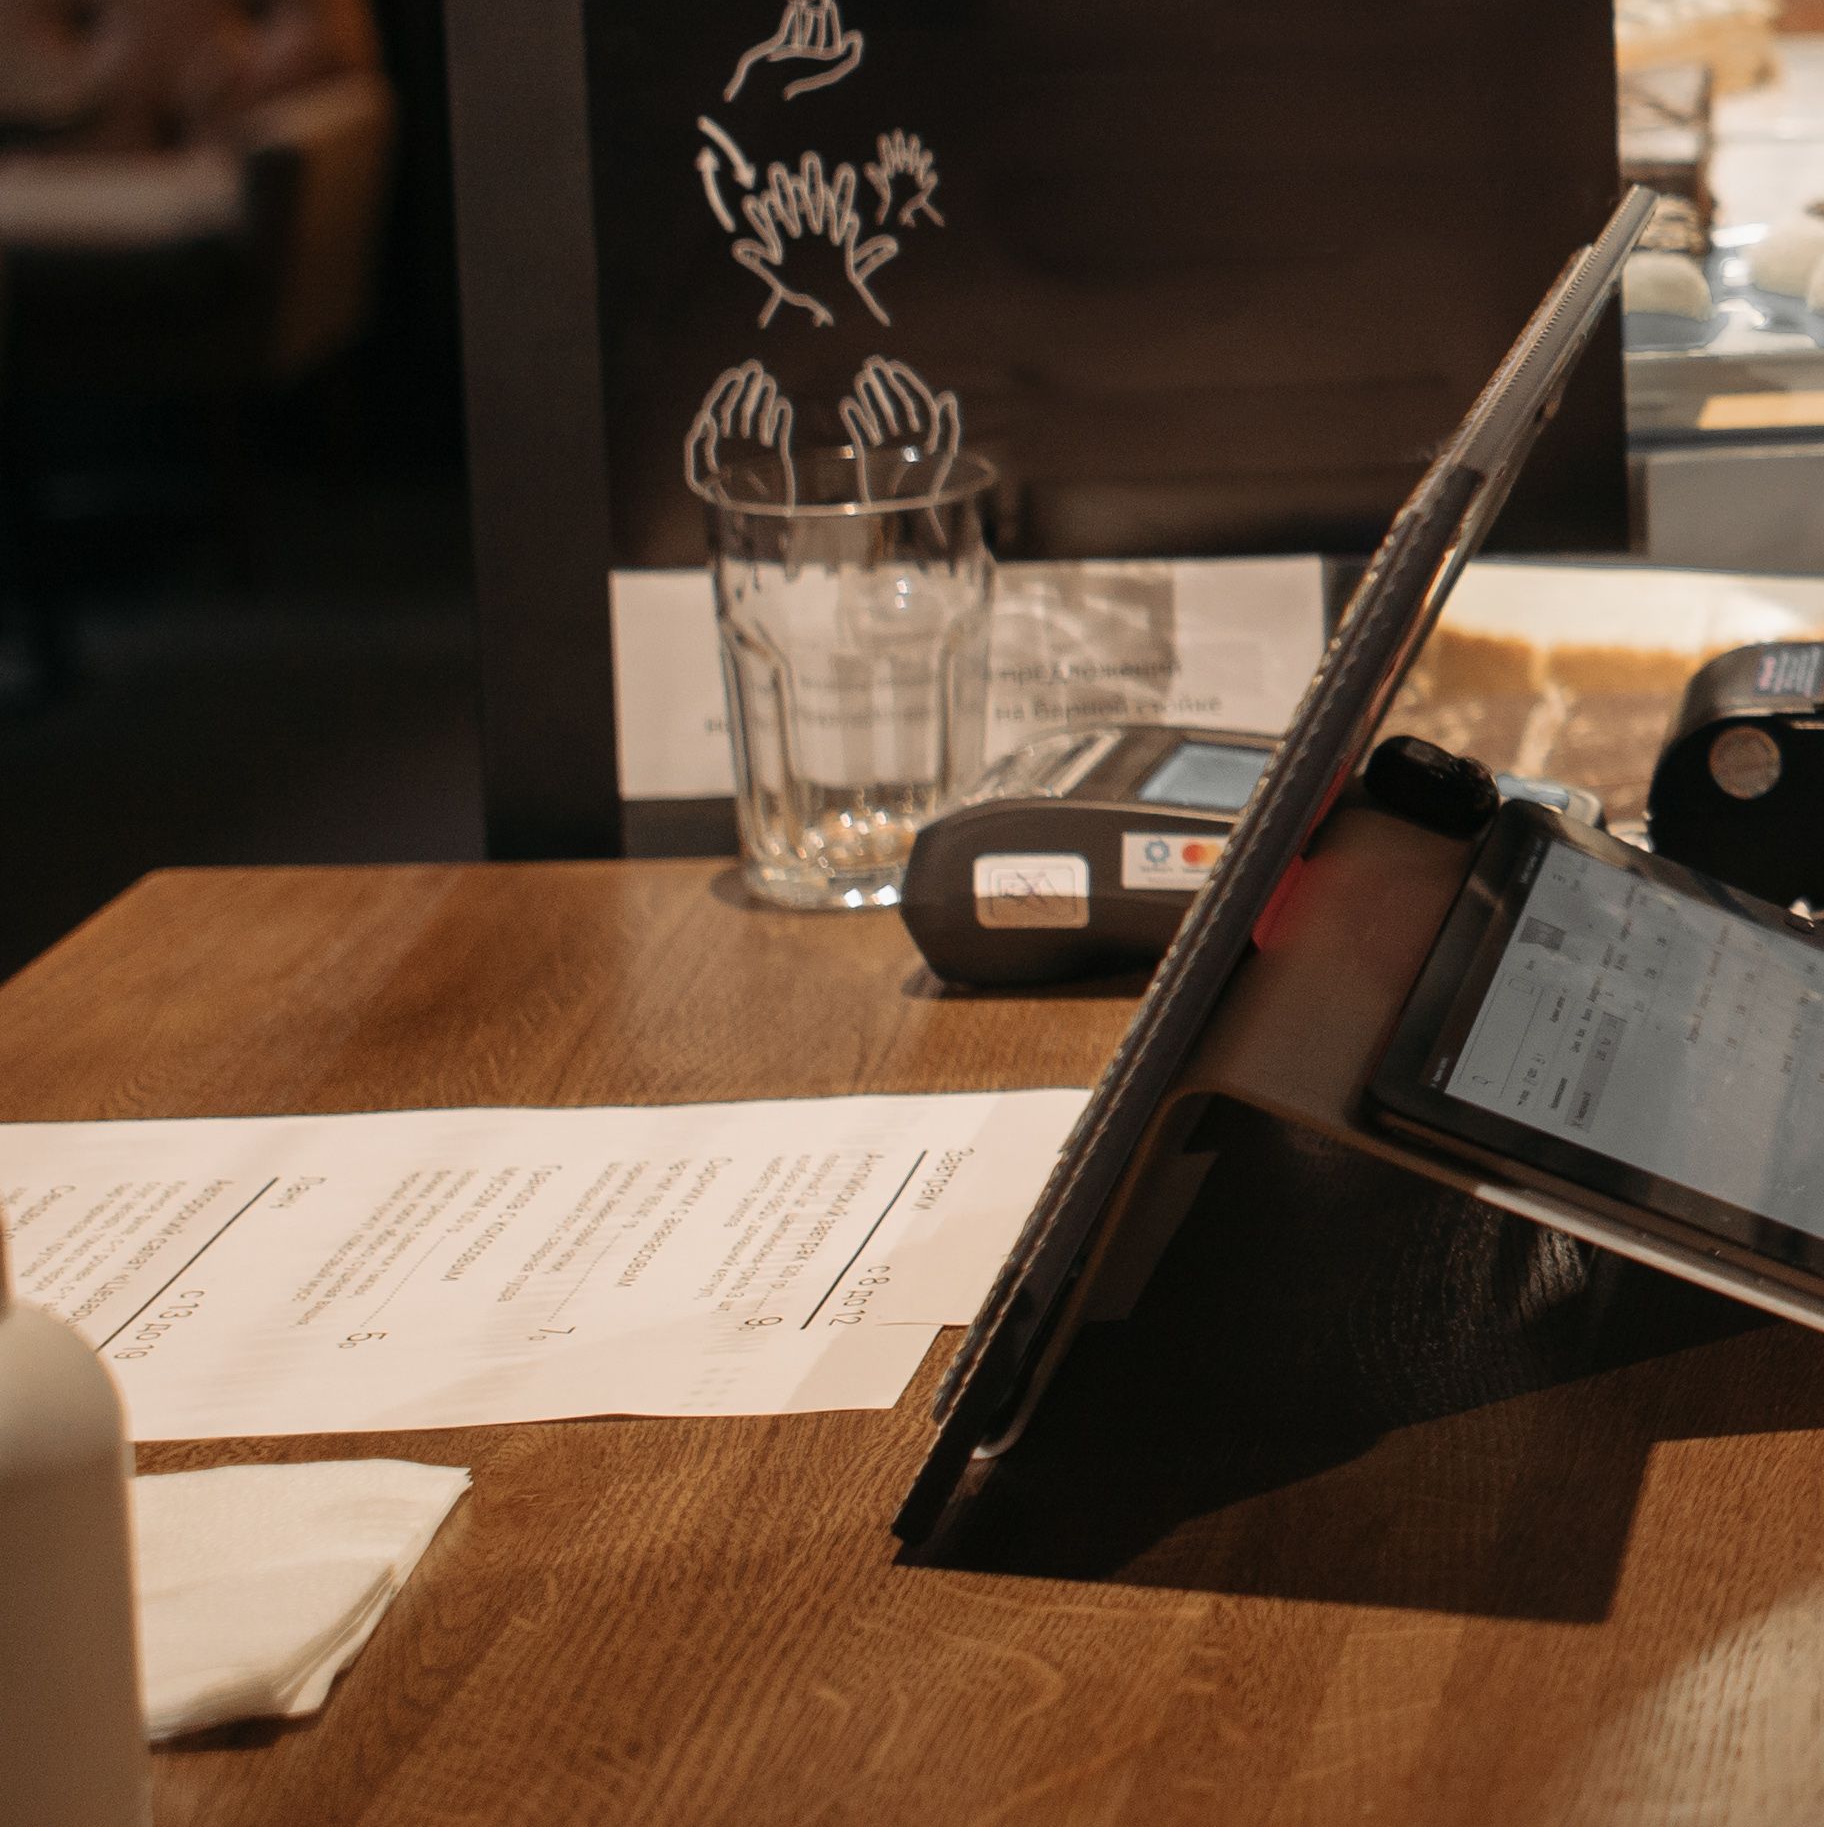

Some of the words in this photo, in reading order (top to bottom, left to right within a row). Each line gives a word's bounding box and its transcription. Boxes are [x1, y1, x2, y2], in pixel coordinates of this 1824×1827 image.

[915, 1148, 974, 1210] Завтраки
[858, 1277, 890, 1286] 8
[843, 1290, 874, 1306] до
[158, 1303, 199, 1319] 13
[828, 1310, 866, 1326] 12
[135, 1323, 171, 1341] до
[114, 1345, 154, 1359] 19
